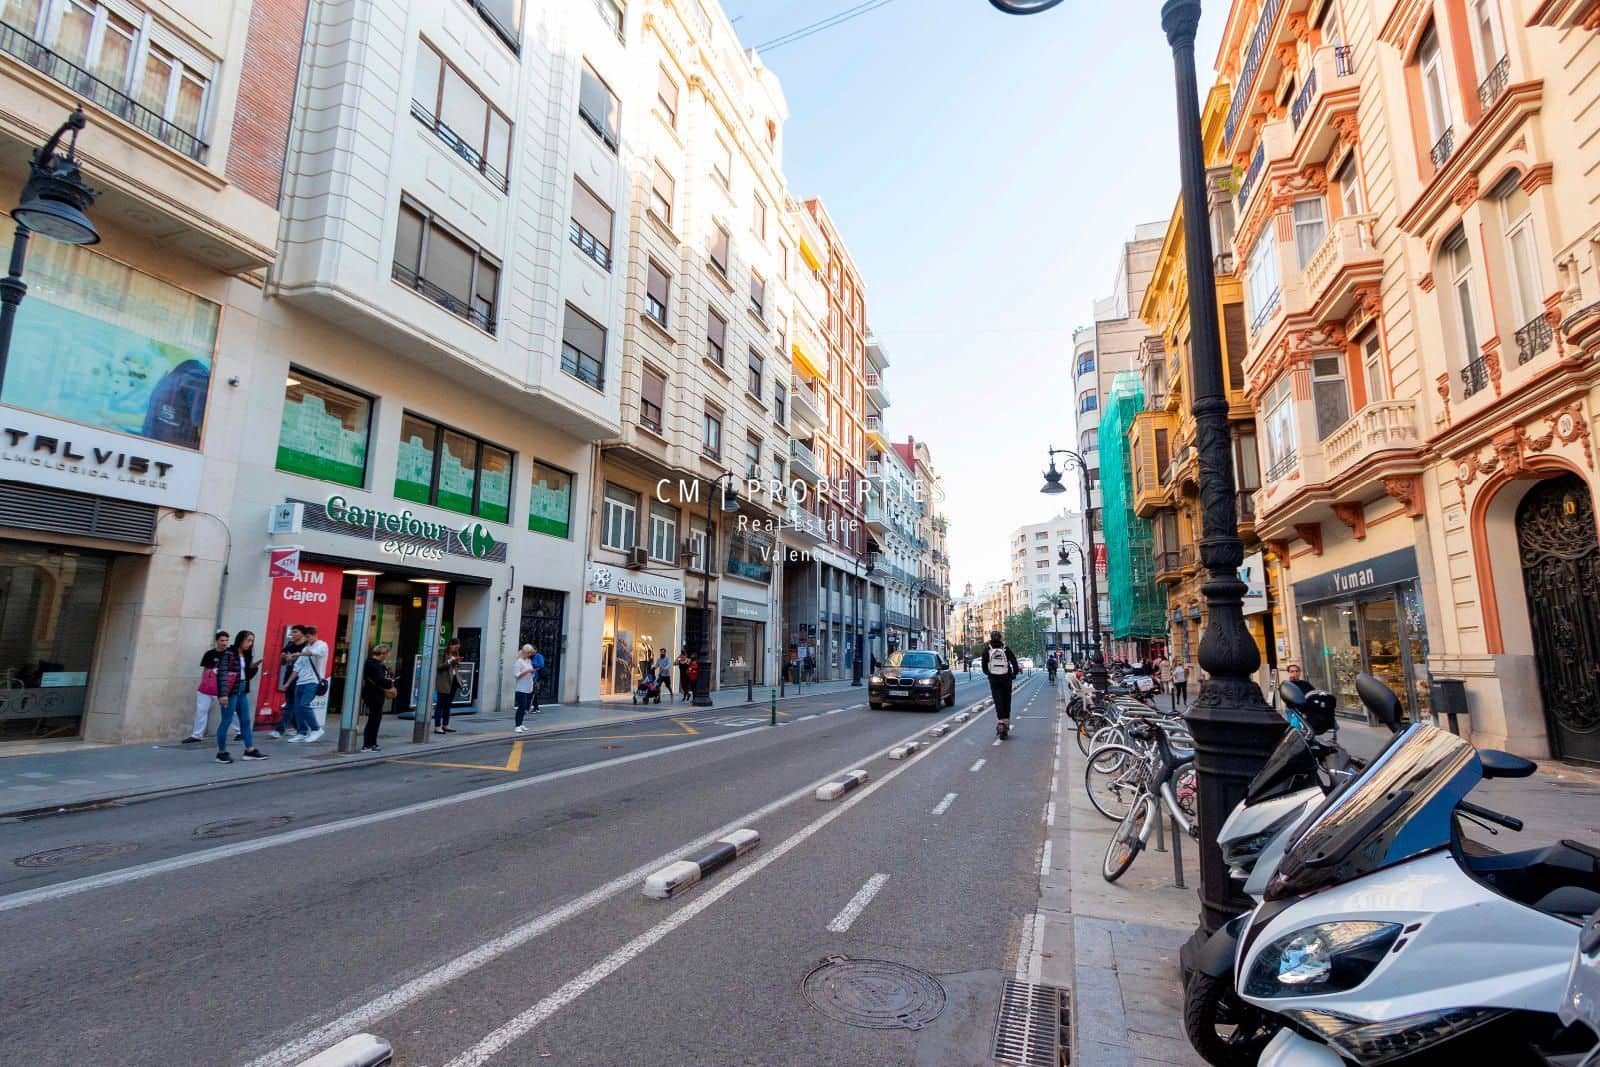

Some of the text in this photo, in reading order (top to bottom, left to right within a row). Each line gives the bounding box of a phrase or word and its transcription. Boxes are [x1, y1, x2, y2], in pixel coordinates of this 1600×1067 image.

[325, 495, 448, 541] Carrefour
[383, 539, 446, 561] express
[292, 569, 325, 585] ATM
[1332, 567, 1375, 593] Yuman
[283, 587, 328, 604] Cajero
